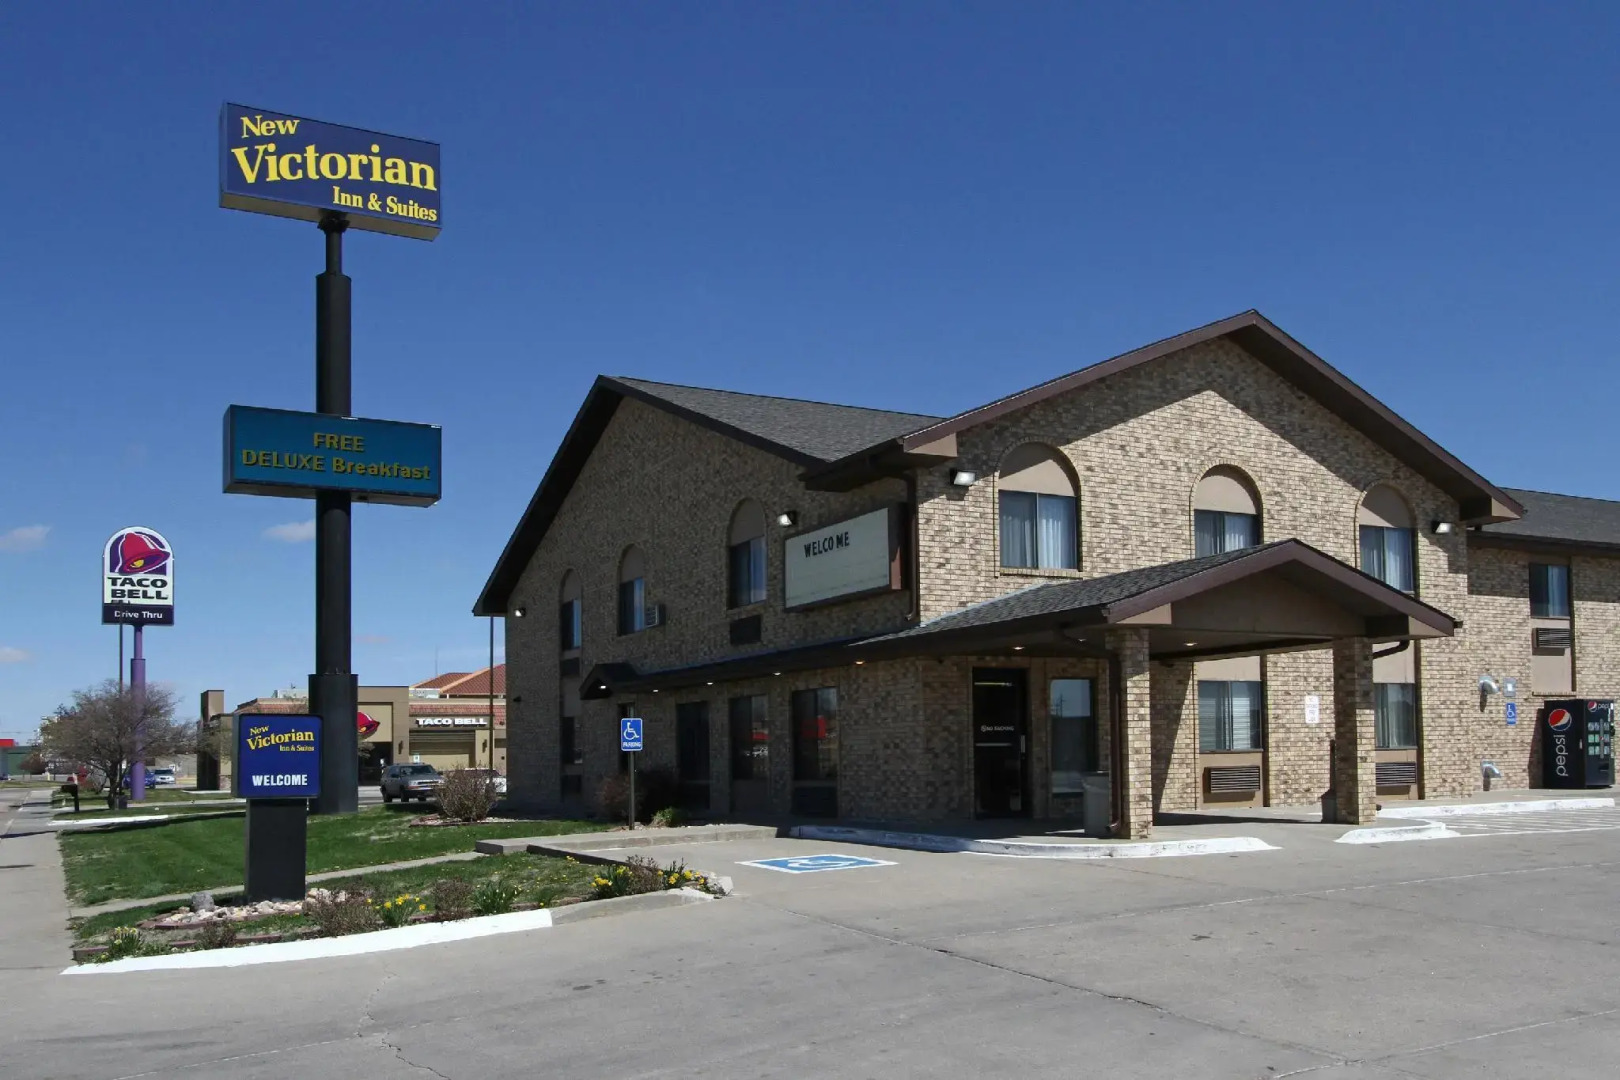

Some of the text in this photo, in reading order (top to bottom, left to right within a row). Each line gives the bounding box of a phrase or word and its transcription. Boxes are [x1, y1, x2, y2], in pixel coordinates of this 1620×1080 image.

[240, 115, 300, 138] New
[231, 143, 437, 191] Victorian
[332, 186, 437, 221] Inn & Suites
[313, 432, 365, 451] FREE
[242, 449, 430, 480] DELUXE Breakfast
[803, 531, 850, 558] WELCOME
[107, 576, 168, 588] TACO
[111, 589, 168, 600] BELL
[114, 610, 163, 619] Drive Thru
[246, 728, 314, 750] Victorian
[249, 725, 269, 736] New
[1553, 734, 1568, 776] pepsi
[252, 774, 308, 786] WELCOME
